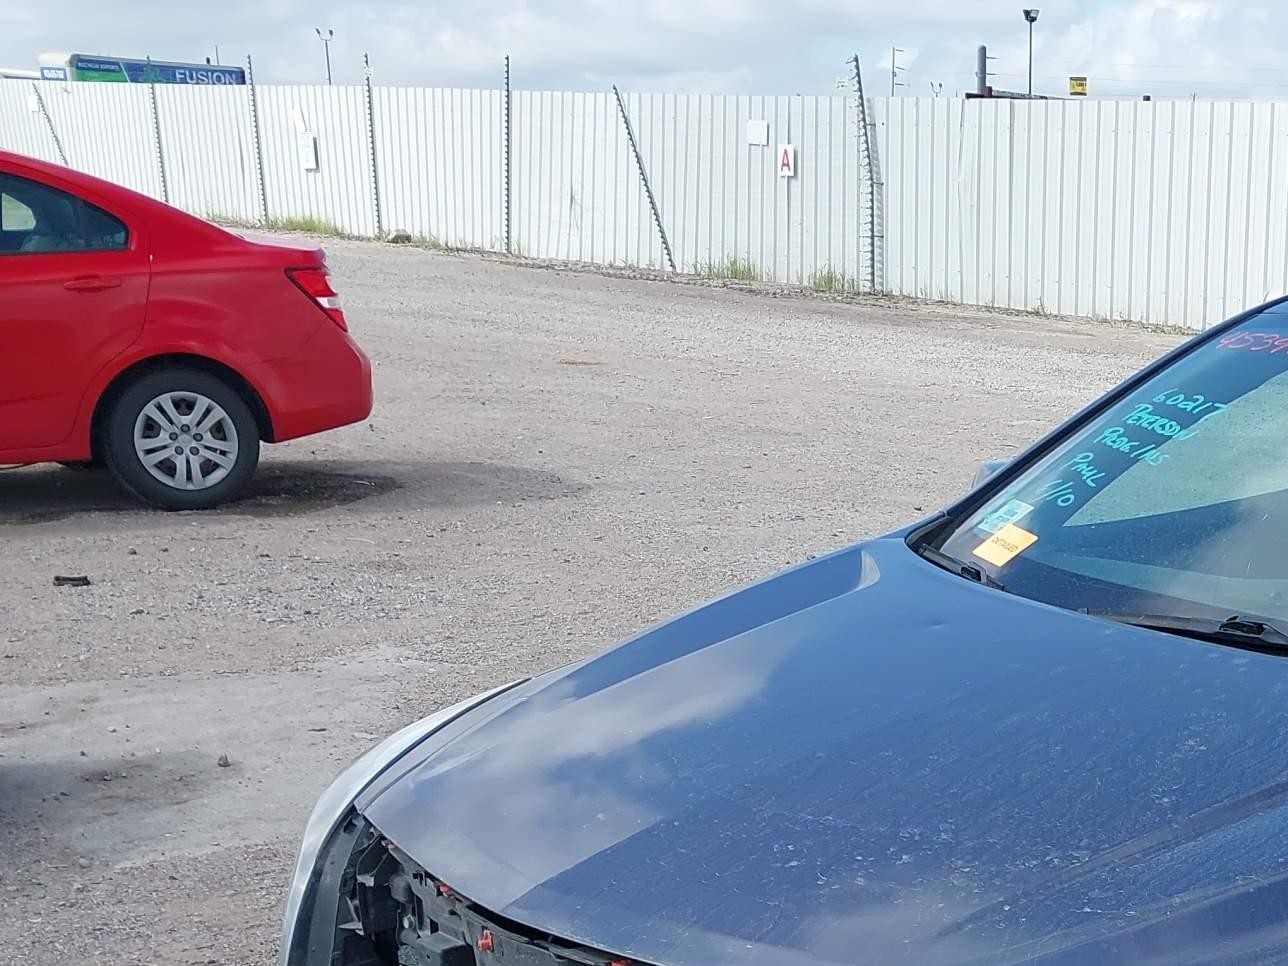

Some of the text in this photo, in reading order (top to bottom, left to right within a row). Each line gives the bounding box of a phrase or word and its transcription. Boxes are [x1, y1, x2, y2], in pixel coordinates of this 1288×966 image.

[175, 69, 237, 85] FUSION
[780, 148, 791, 172] A
[1060, 452, 1106, 487] PAUL
